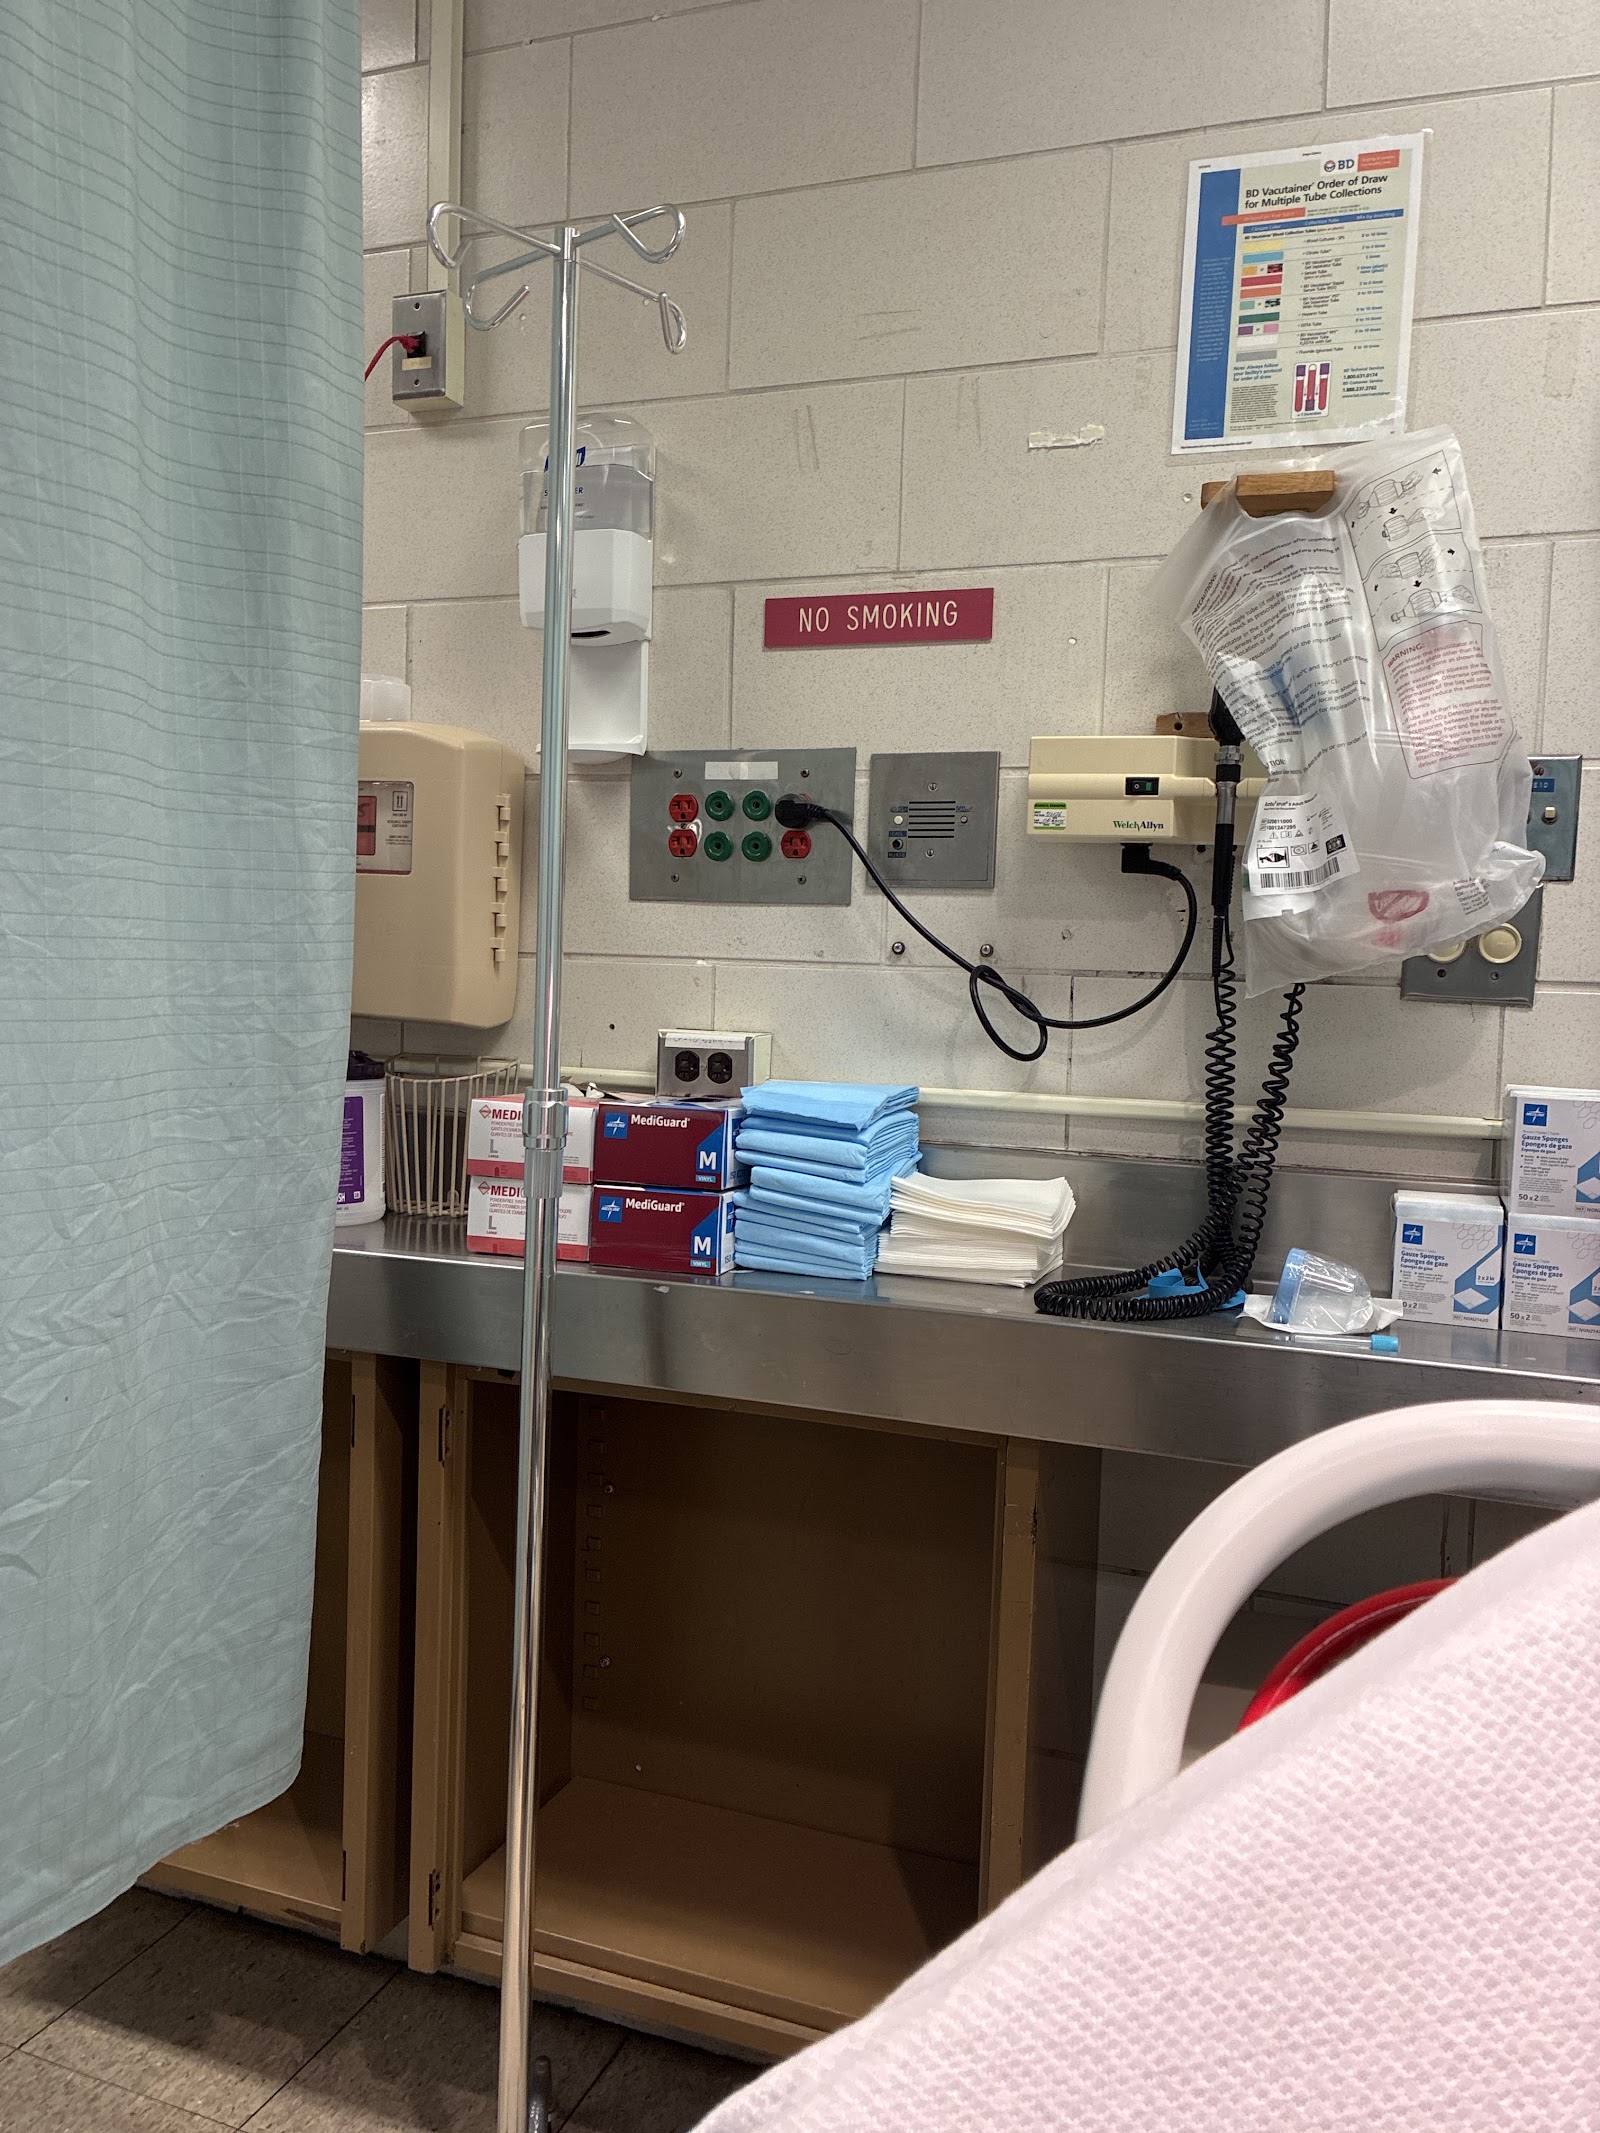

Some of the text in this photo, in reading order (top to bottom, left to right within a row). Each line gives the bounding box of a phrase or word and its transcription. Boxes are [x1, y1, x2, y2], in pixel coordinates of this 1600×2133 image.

[1338, 159, 1354, 170] BD
[1246, 189, 1259, 198] BD
[1317, 178, 1345, 190] Order
[1348, 176, 1359, 186] of
[1362, 175, 1388, 185] Draw
[1245, 186, 1382, 209] for Multiple Tube Collections
[1246, 606, 1258, 615] tube
[1266, 595, 1275, 603] not
[799, 600, 958, 633] NO SMOKING
[1230, 622, 1246, 633] check
[1254, 600, 1280, 620] prescribed
[1260, 613, 1279, 628] carrying
[1291, 622, 1310, 632] stored
[1234, 638, 1252, 650] airway
[1253, 631, 1264, 640] and
[1313, 633, 1342, 644] important
[1237, 642, 1259, 656] location
[1446, 665, 1468, 673] squeeze
[1442, 671, 1470, 680] Otherwise
[1432, 689, 1452, 699] reduce
[1330, 698, 1357, 710] expiration
[1448, 708, 1472, 716] Detector
[1444, 716, 1468, 725] between
[1347, 736, 1361, 747] order
[492, 1109, 522, 1120] MEDI
[490, 1139, 498, 1153] L
[1522, 1140, 1548, 1149] Éponges
[699, 1151, 716, 1170] M
[489, 1216, 497, 1230] L
[694, 1236, 711, 1255] M
[1401, 1250, 1419, 1258] Gauze
[1401, 1257, 1425, 1266] Éponges
[1533, 1262, 1559, 1271] Sponges
[1513, 1267, 1538, 1276] Éponges
